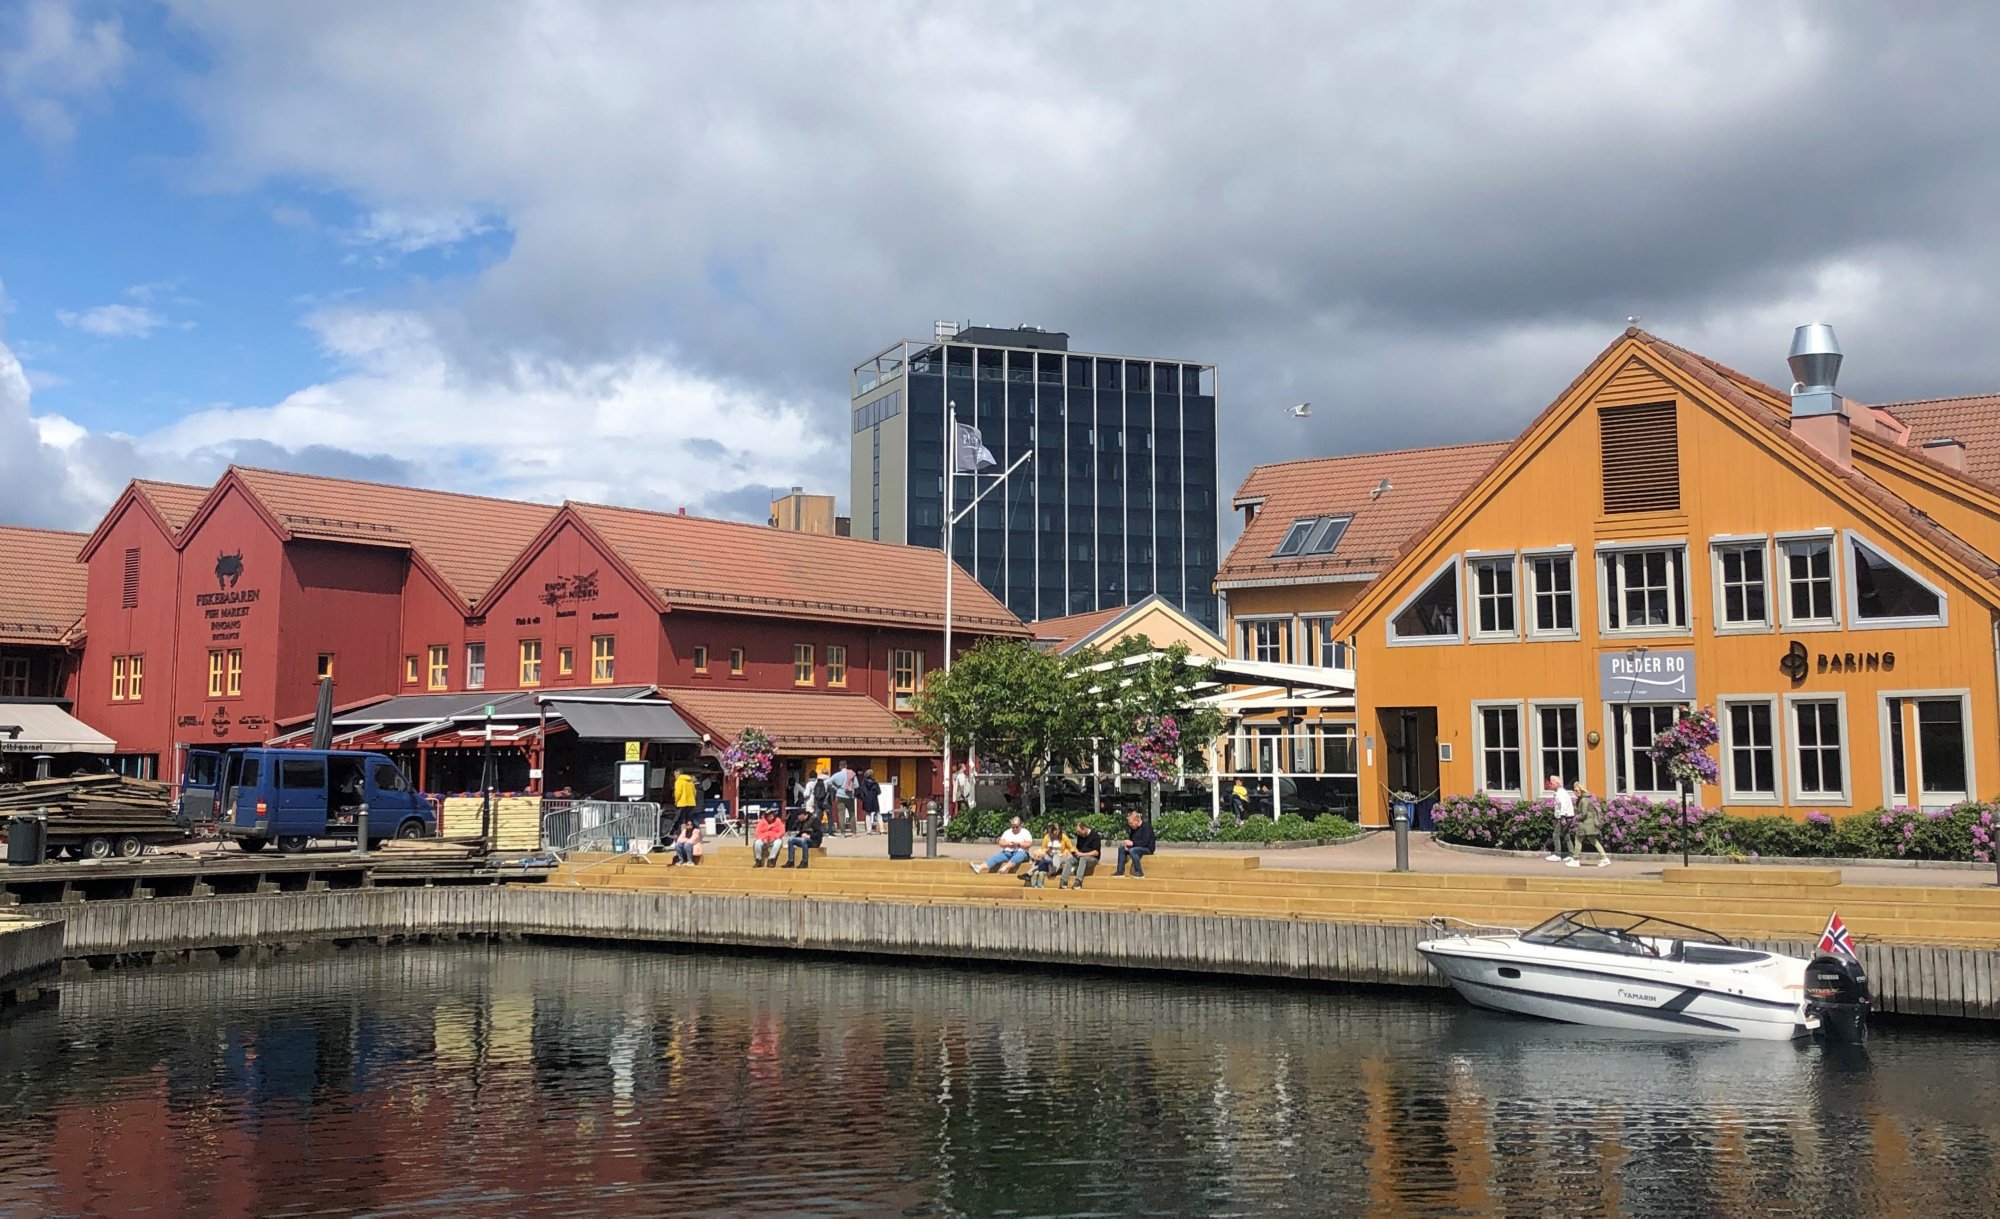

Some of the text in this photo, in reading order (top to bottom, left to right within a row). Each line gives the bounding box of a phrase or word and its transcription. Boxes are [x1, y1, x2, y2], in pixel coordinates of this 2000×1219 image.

[196, 589, 260, 606] FISKEBASAREN
[221, 606, 250, 618] MARKET
[1612, 656, 1685, 674] PIEDER RO
[1817, 652, 1895, 670] BARING
[1623, 991, 1657, 1002] YAMARIN
